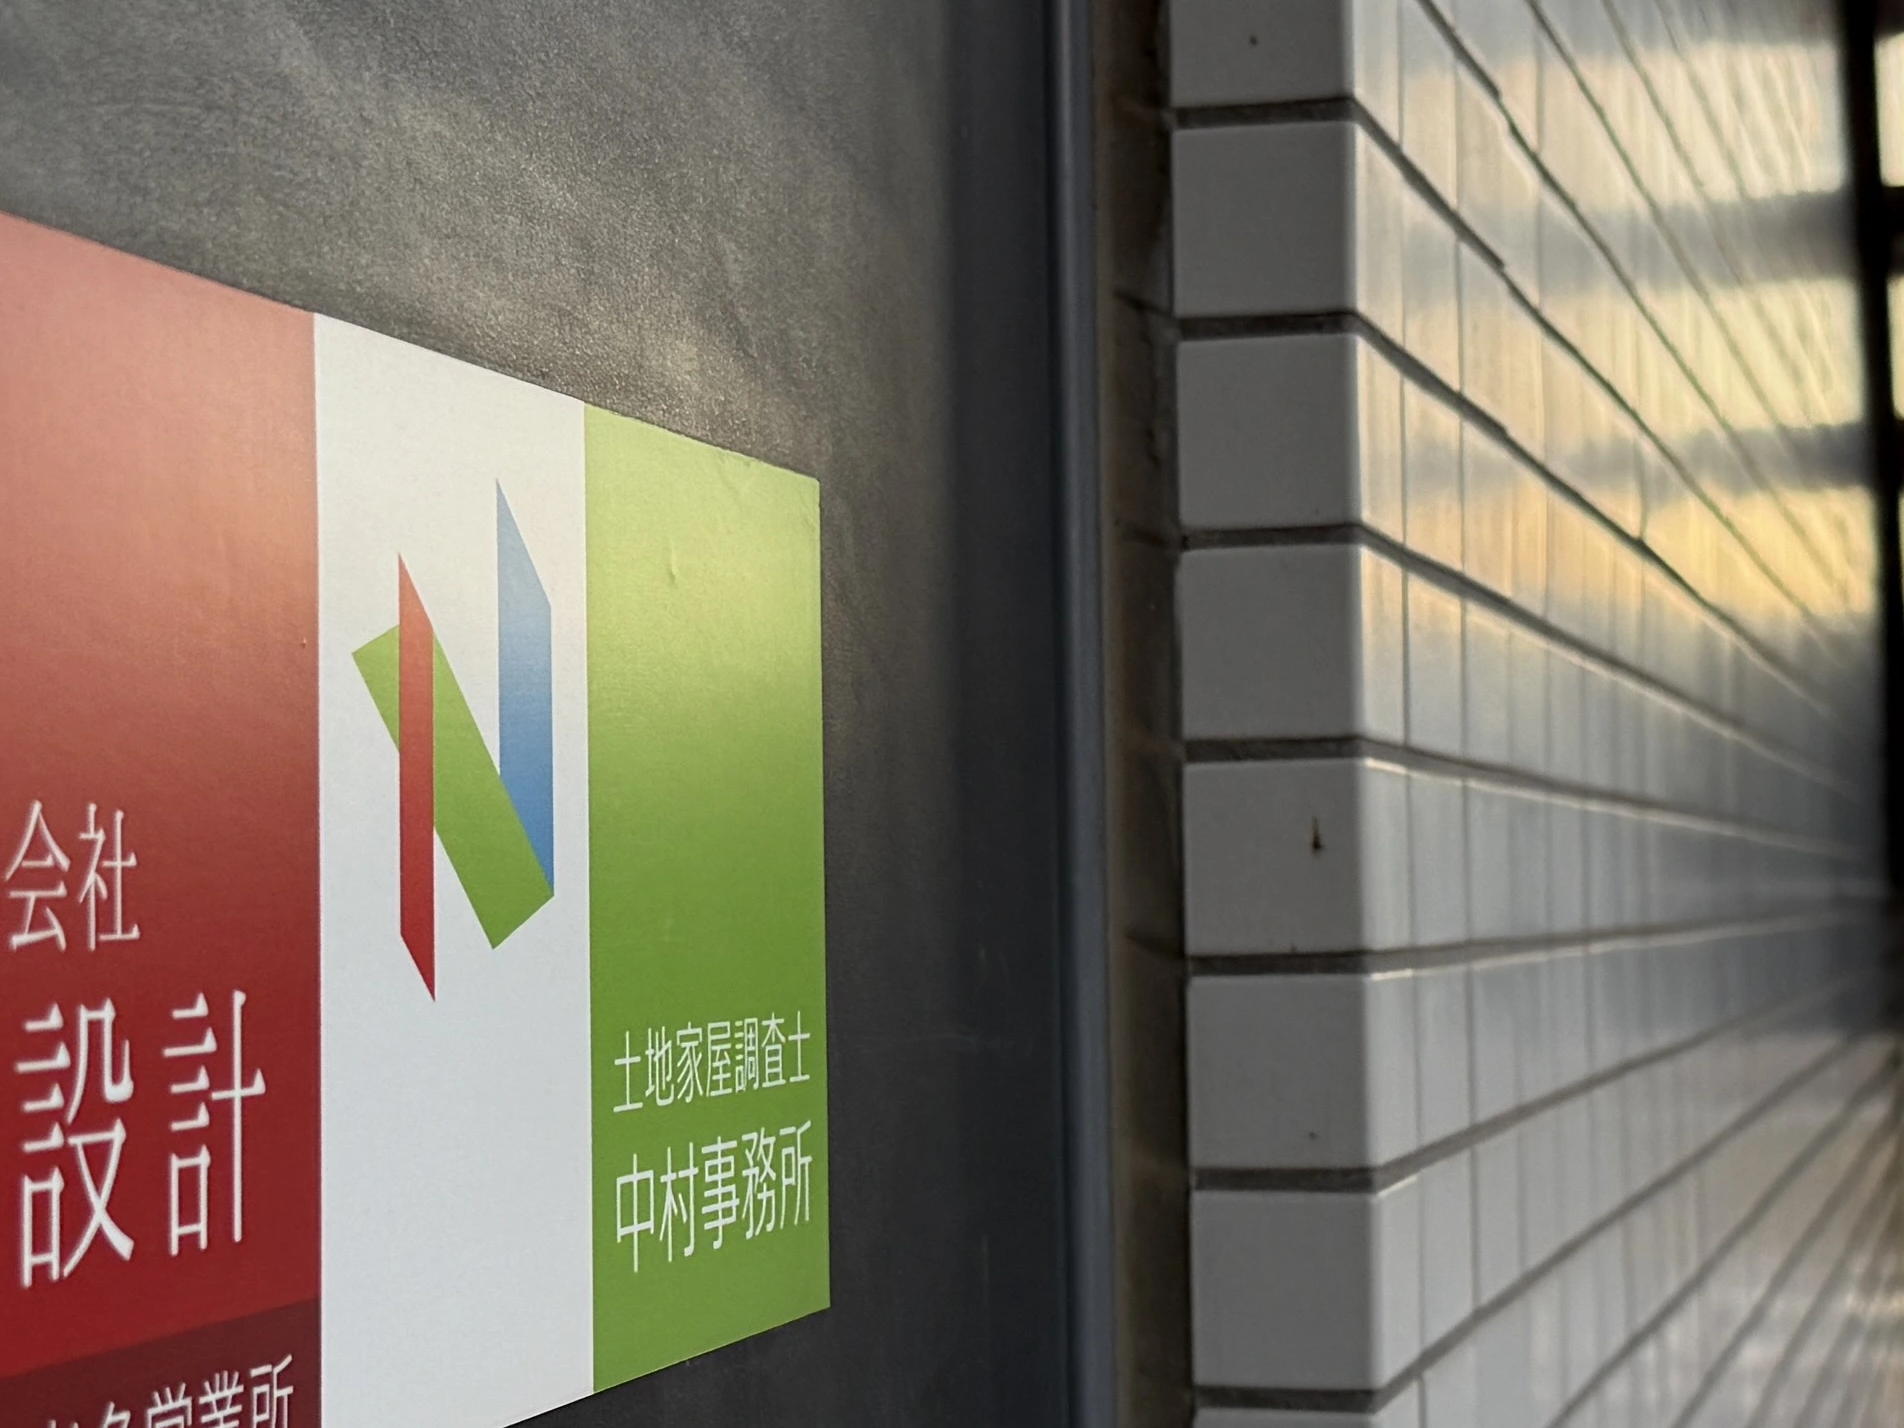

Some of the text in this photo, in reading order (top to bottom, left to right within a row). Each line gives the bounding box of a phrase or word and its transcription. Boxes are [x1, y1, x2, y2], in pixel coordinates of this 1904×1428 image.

[613, 1010, 812, 1114] 土地家屋調査士
[615, 1119, 814, 1274] 中村事務所
